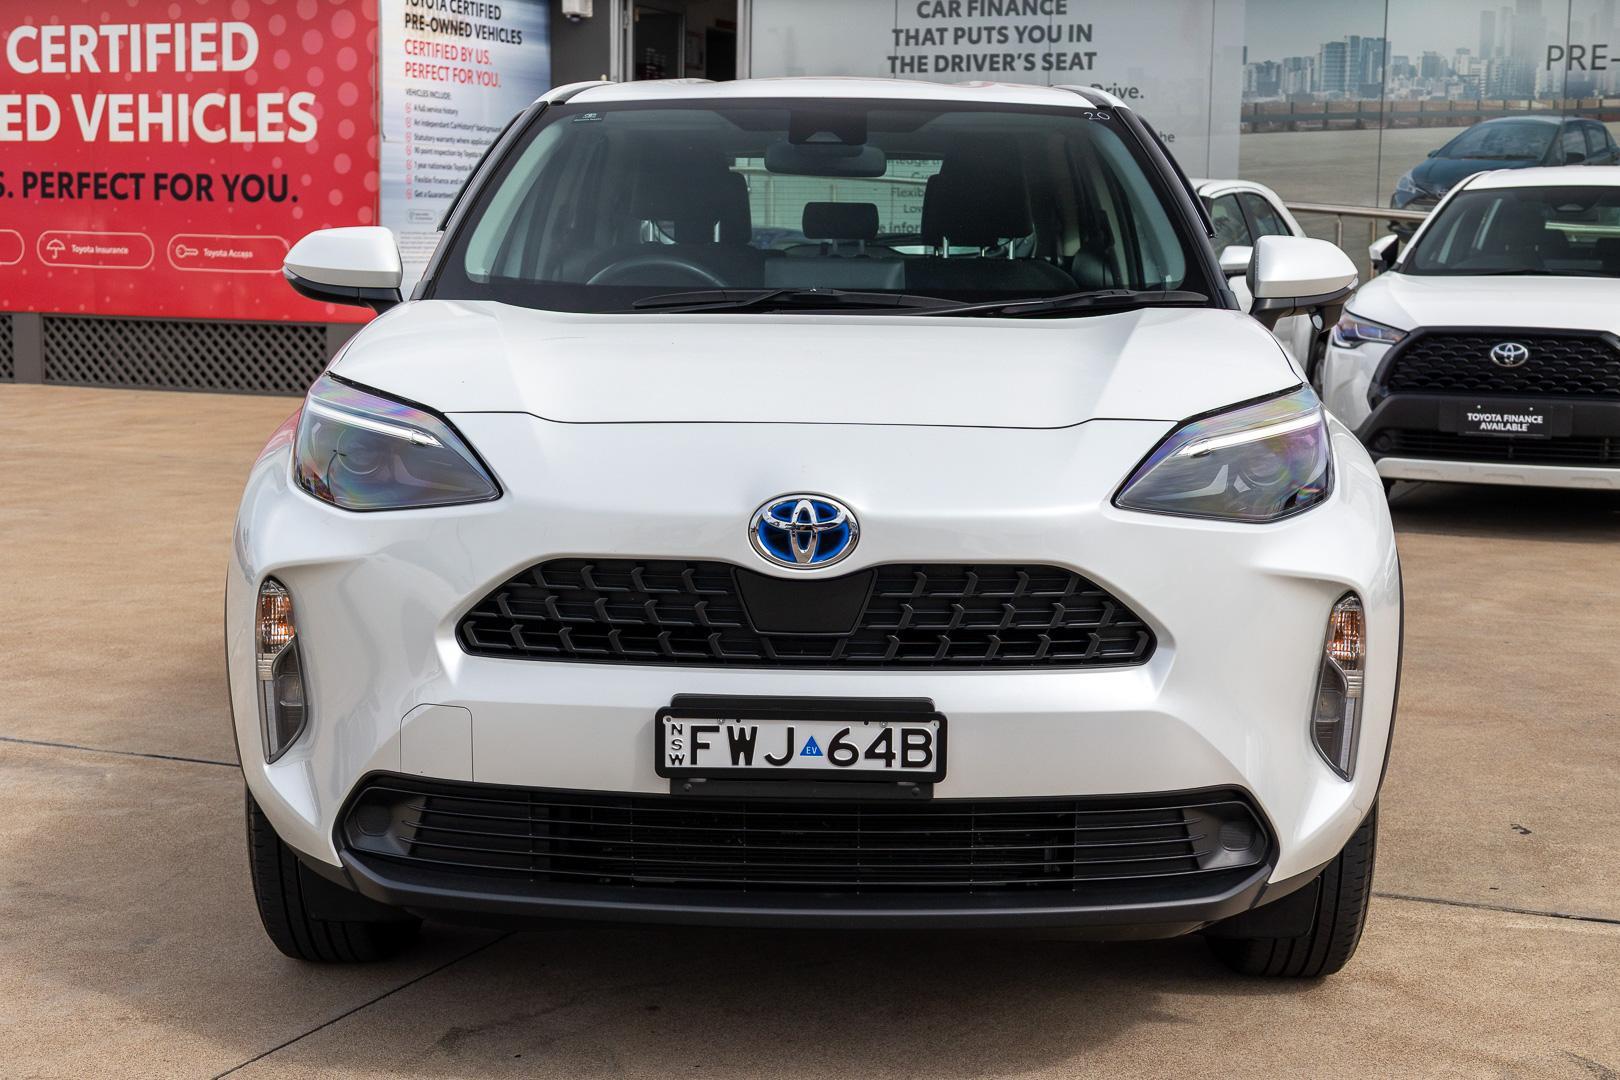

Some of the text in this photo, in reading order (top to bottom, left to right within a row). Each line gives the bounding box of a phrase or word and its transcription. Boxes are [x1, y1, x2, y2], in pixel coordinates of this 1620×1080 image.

[449, 0, 501, 20] CERTIFIED
[916, 0, 1067, 18] CAR FINANCE
[404, 13, 522, 45] PRE-OWNED VEHICLES
[892, 24, 1092, 46] THAT PUTS YOU IN
[6, 22, 260, 74] CERTIFIED
[404, 39, 492, 65] CERTIFIED BY US.
[1546, 44, 1620, 71] PRE-
[405, 61, 501, 88] PERFECT FOR YOU.
[887, 52, 1097, 74] THE DRIVER’S SEAT
[1091, 83, 1144, 99] rive.
[0, 92, 318, 143] ED VEHICLES
[22, 171, 145, 200] PERFECT
[153, 173, 214, 202] FOR
[222, 174, 298, 203] YOU.
[72, 244, 129, 255] Toyota Insurance
[1467, 413, 1543, 425] TOYOTA FINANCE
[690, 725, 933, 768] FWJ EV 64B
